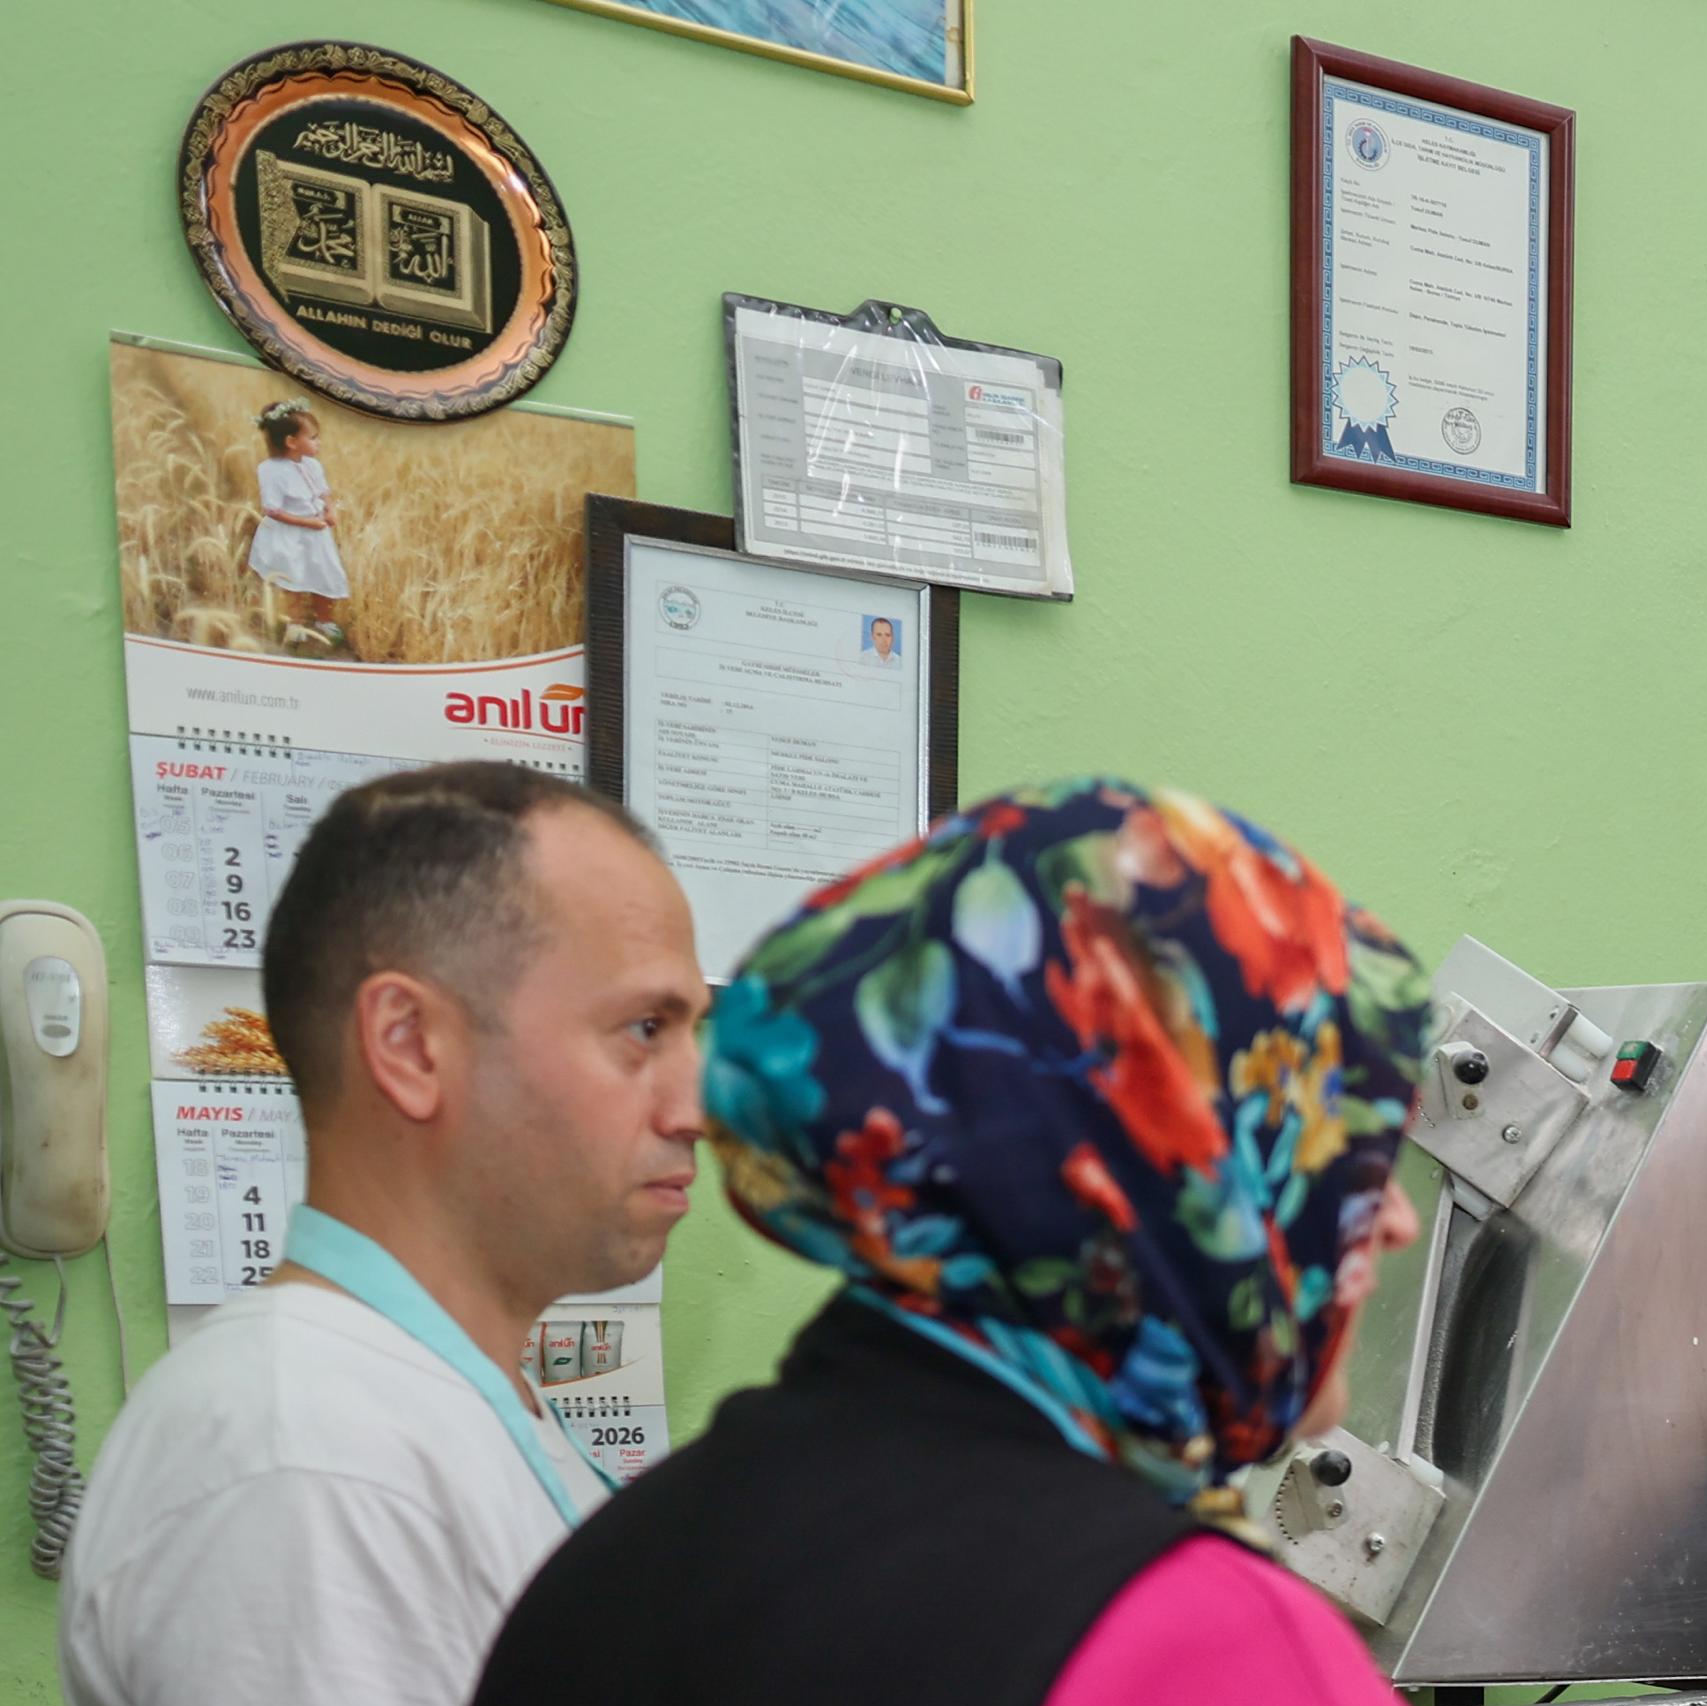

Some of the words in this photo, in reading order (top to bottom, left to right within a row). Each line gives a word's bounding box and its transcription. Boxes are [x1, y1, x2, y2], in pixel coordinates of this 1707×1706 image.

[296, 304, 367, 329] ALLAHIN
[372, 318, 423, 340] DEDİĞİ
[429, 331, 474, 350] OLUR
[156, 761, 227, 781] ŞUBAT
[243, 769, 315, 788] FEBRUARY
[157, 784, 188, 796] Hafta
[201, 787, 255, 801] Pazartesi
[224, 847, 241, 867] 2
[226, 874, 243, 894] 9
[221, 900, 251, 921] 16
[223, 928, 256, 949] 23
[176, 1106, 244, 1122] MAYIS
[259, 1109, 292, 1121] MAY
[176, 1127, 209, 1138] Hafta
[221, 1127, 275, 1139] Pazartesi
[243, 1186, 262, 1205] 4
[242, 1213, 265, 1232] 11
[241, 1239, 270, 1259] 18
[592, 1427, 645, 1447] 2026
[619, 1448, 645, 1458] Pazar
